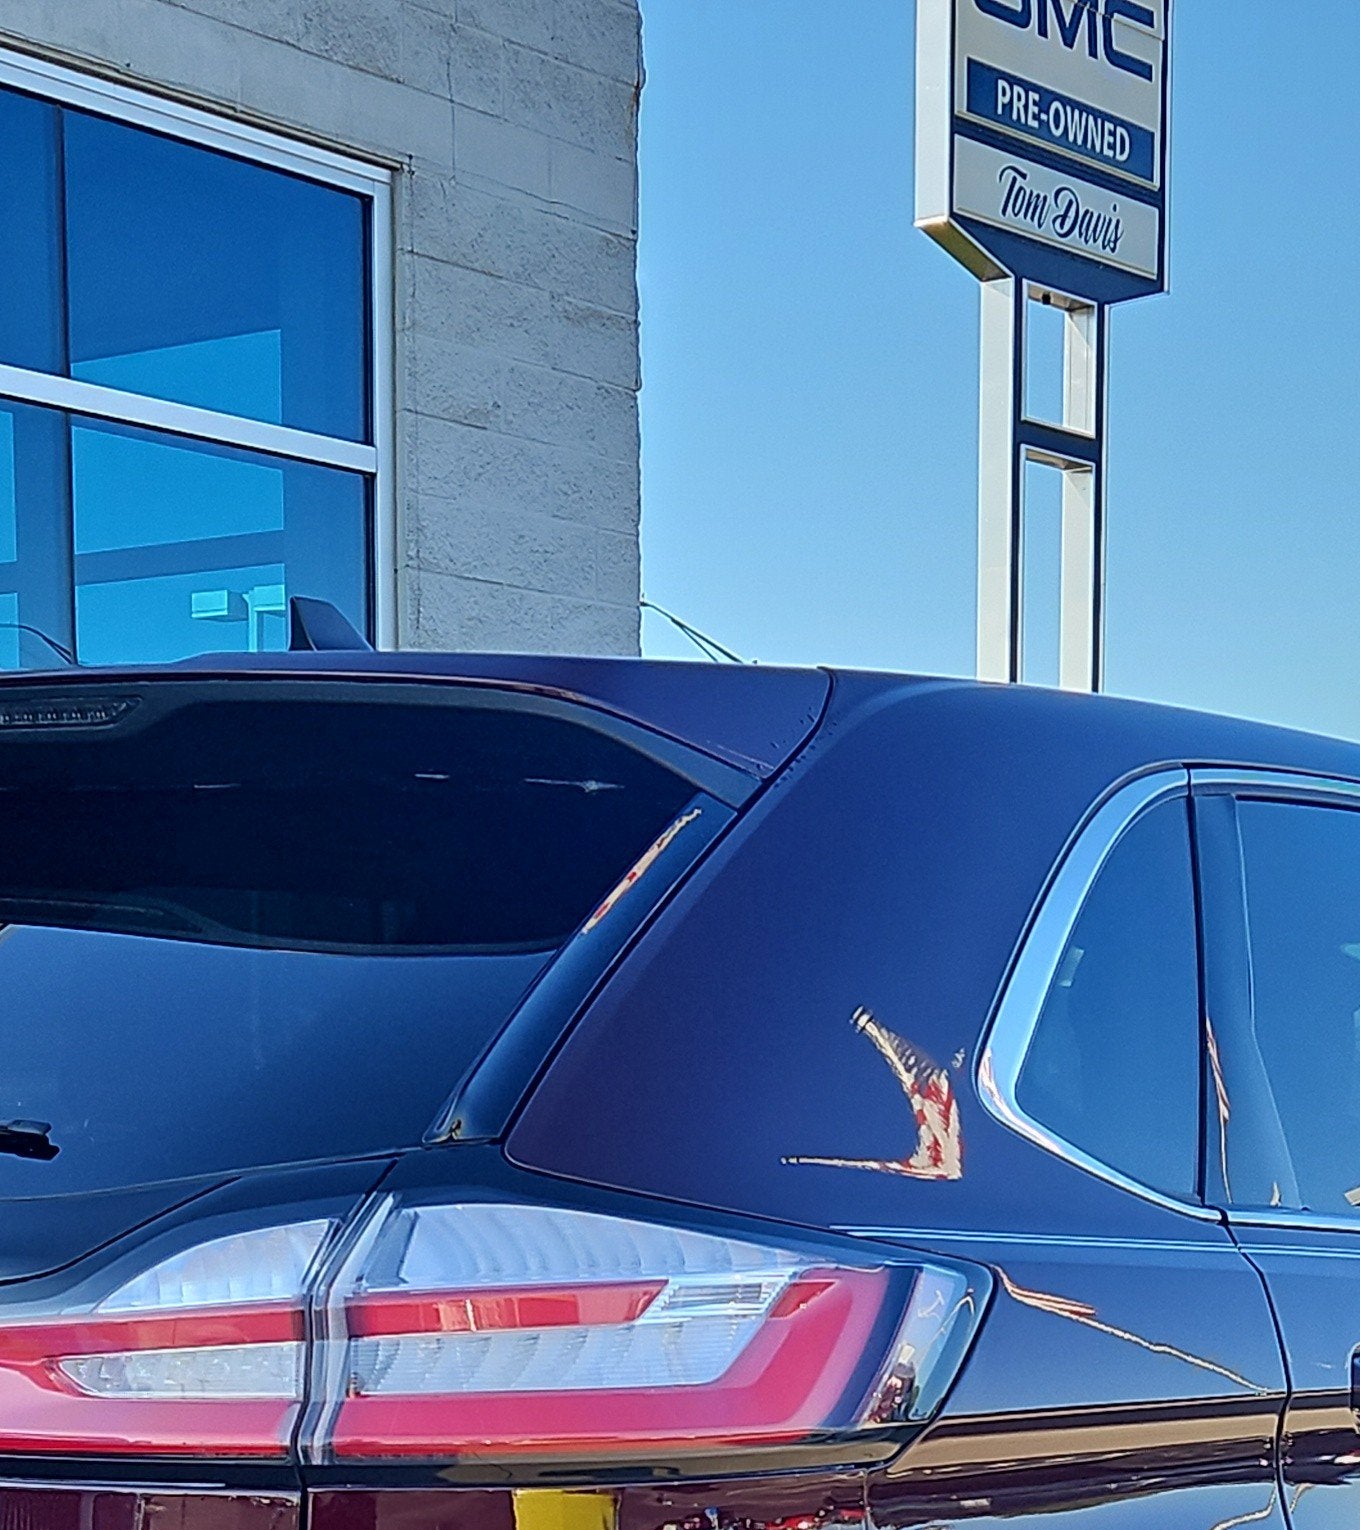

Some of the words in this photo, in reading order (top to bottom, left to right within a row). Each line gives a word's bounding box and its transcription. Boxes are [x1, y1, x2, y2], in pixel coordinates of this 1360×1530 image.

[996, 78, 1131, 163] PRE-OWNED
[998, 165, 1053, 230] Tom
[1051, 186, 1125, 254] Davis
